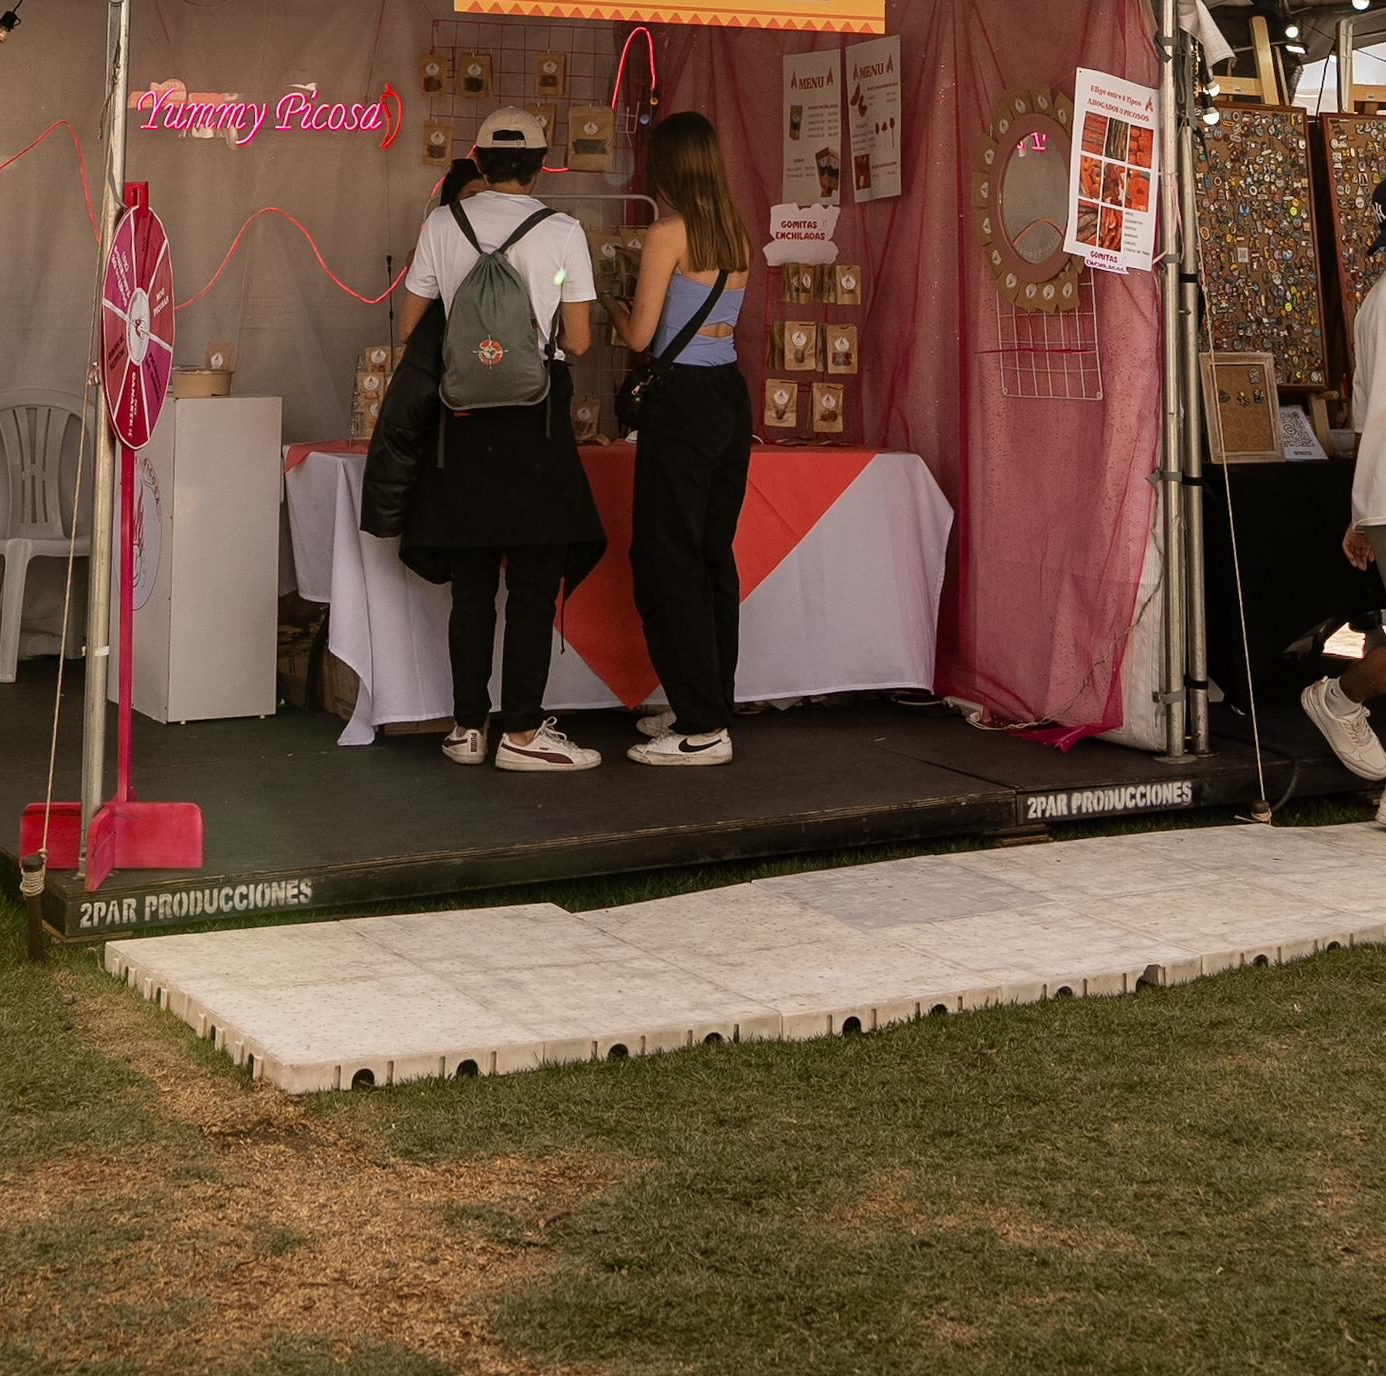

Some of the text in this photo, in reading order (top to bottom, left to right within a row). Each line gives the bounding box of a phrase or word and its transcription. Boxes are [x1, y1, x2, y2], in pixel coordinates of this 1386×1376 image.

[859, 62, 885, 80] MENU
[798, 75, 825, 91] MENU
[137, 87, 384, 145] Yummy Picosa
[780, 220, 818, 230] GOMITAS
[775, 231, 826, 241] ENCHILADAS
[1090, 250, 1118, 264] GOMITAS
[1027, 780, 1193, 820] 2PAR PRODUCCIONES
[79, 878, 313, 928] 2PAR PRODUCCIONES
